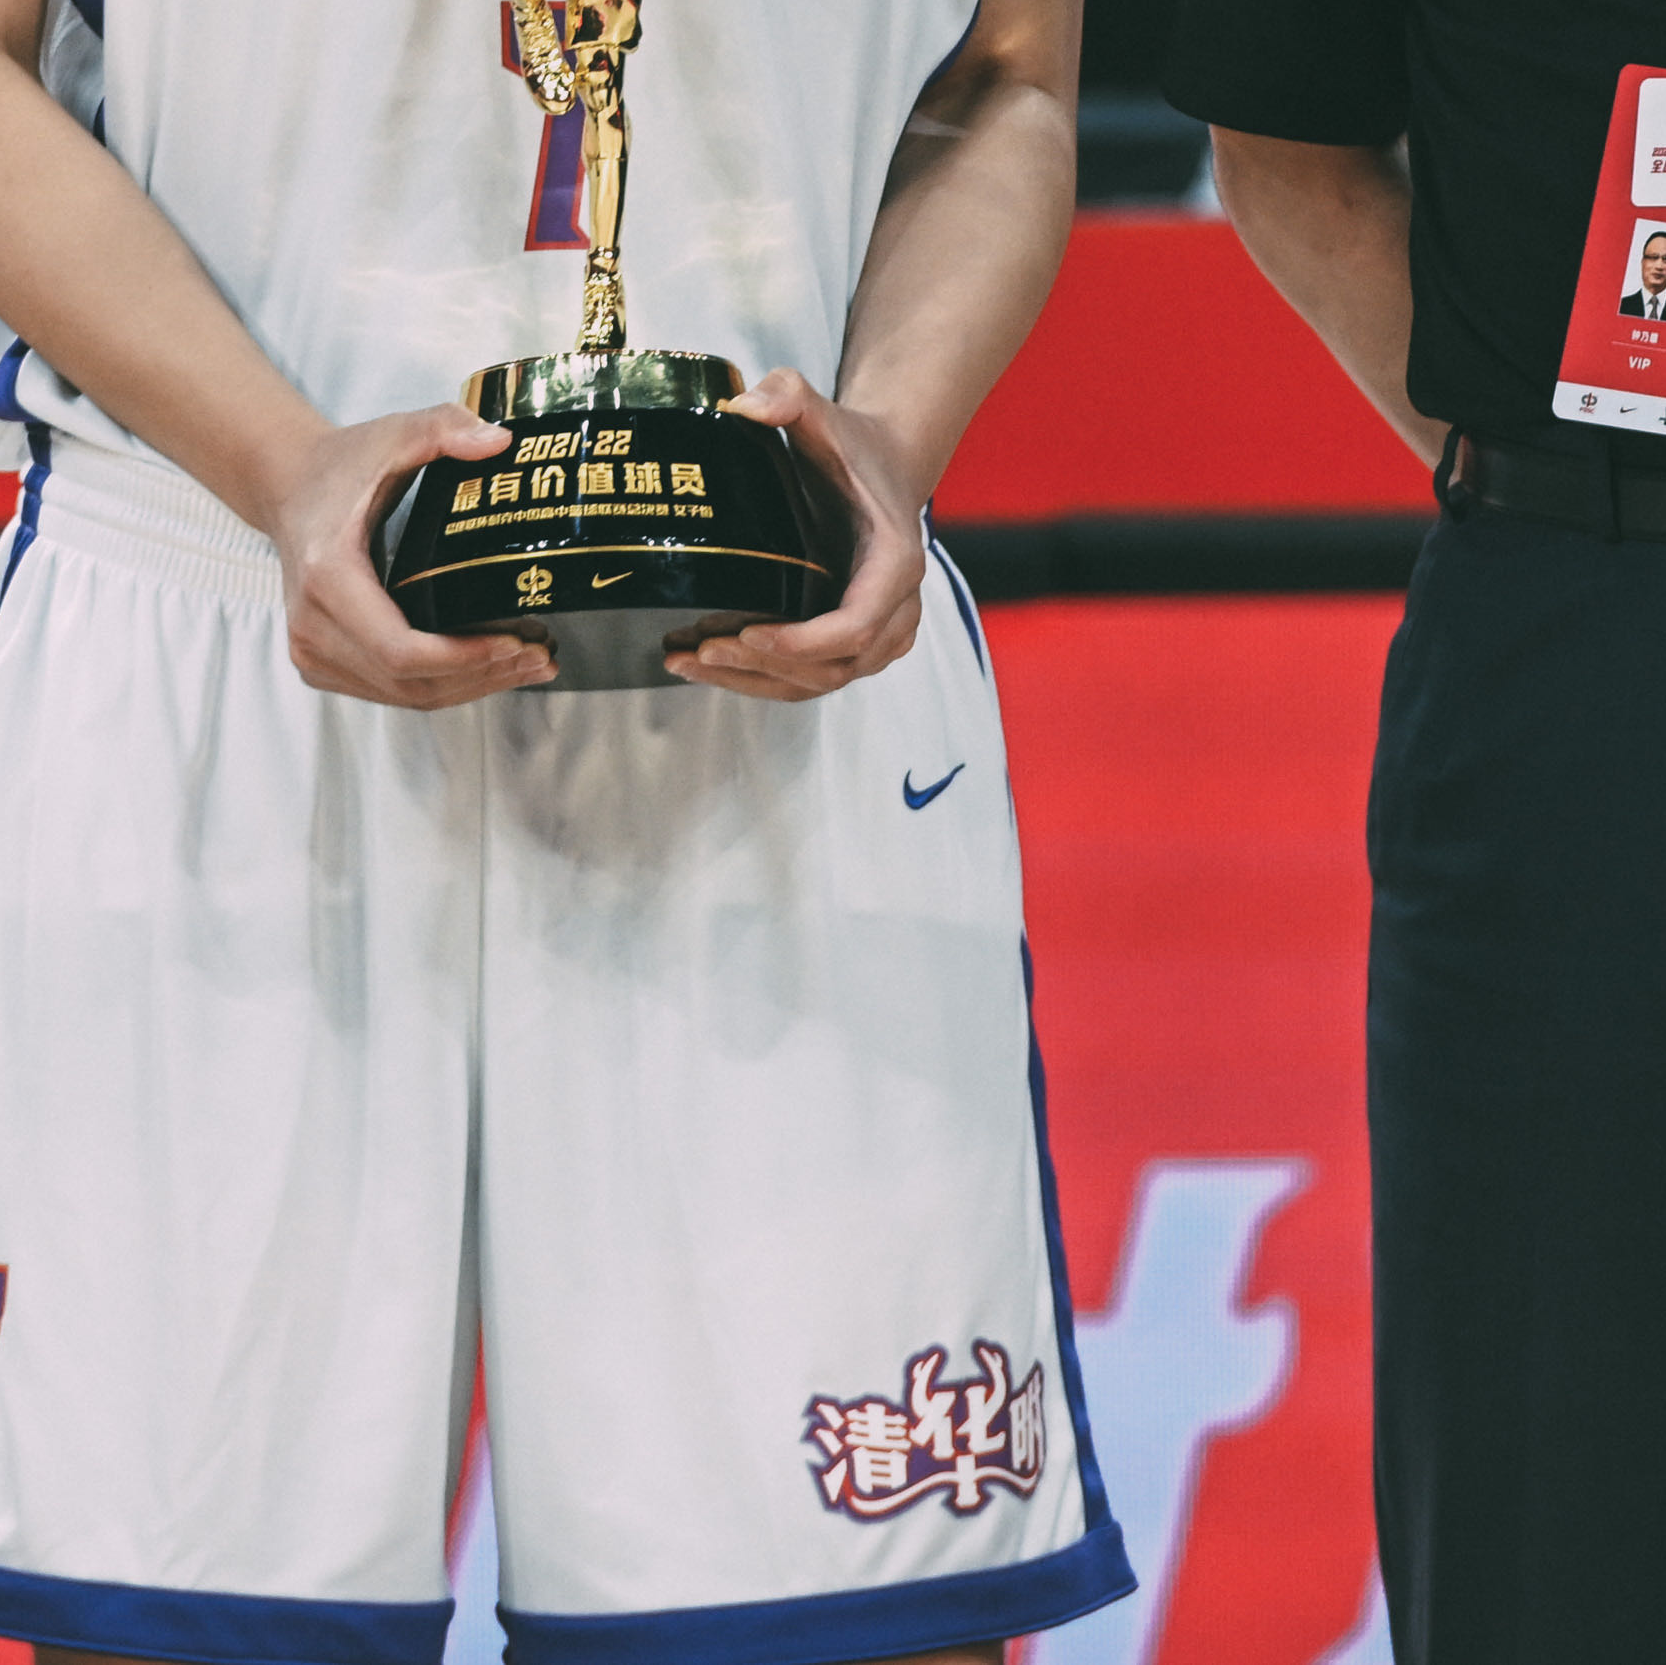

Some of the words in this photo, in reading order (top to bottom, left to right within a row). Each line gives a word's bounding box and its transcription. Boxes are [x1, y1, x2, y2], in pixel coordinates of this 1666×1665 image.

[1629, 355, 1651, 370] VIP
[514, 429, 633, 465] 2021-22
[451, 461, 707, 514] 最有价值球员
[517, 593, 553, 608] FSSC
